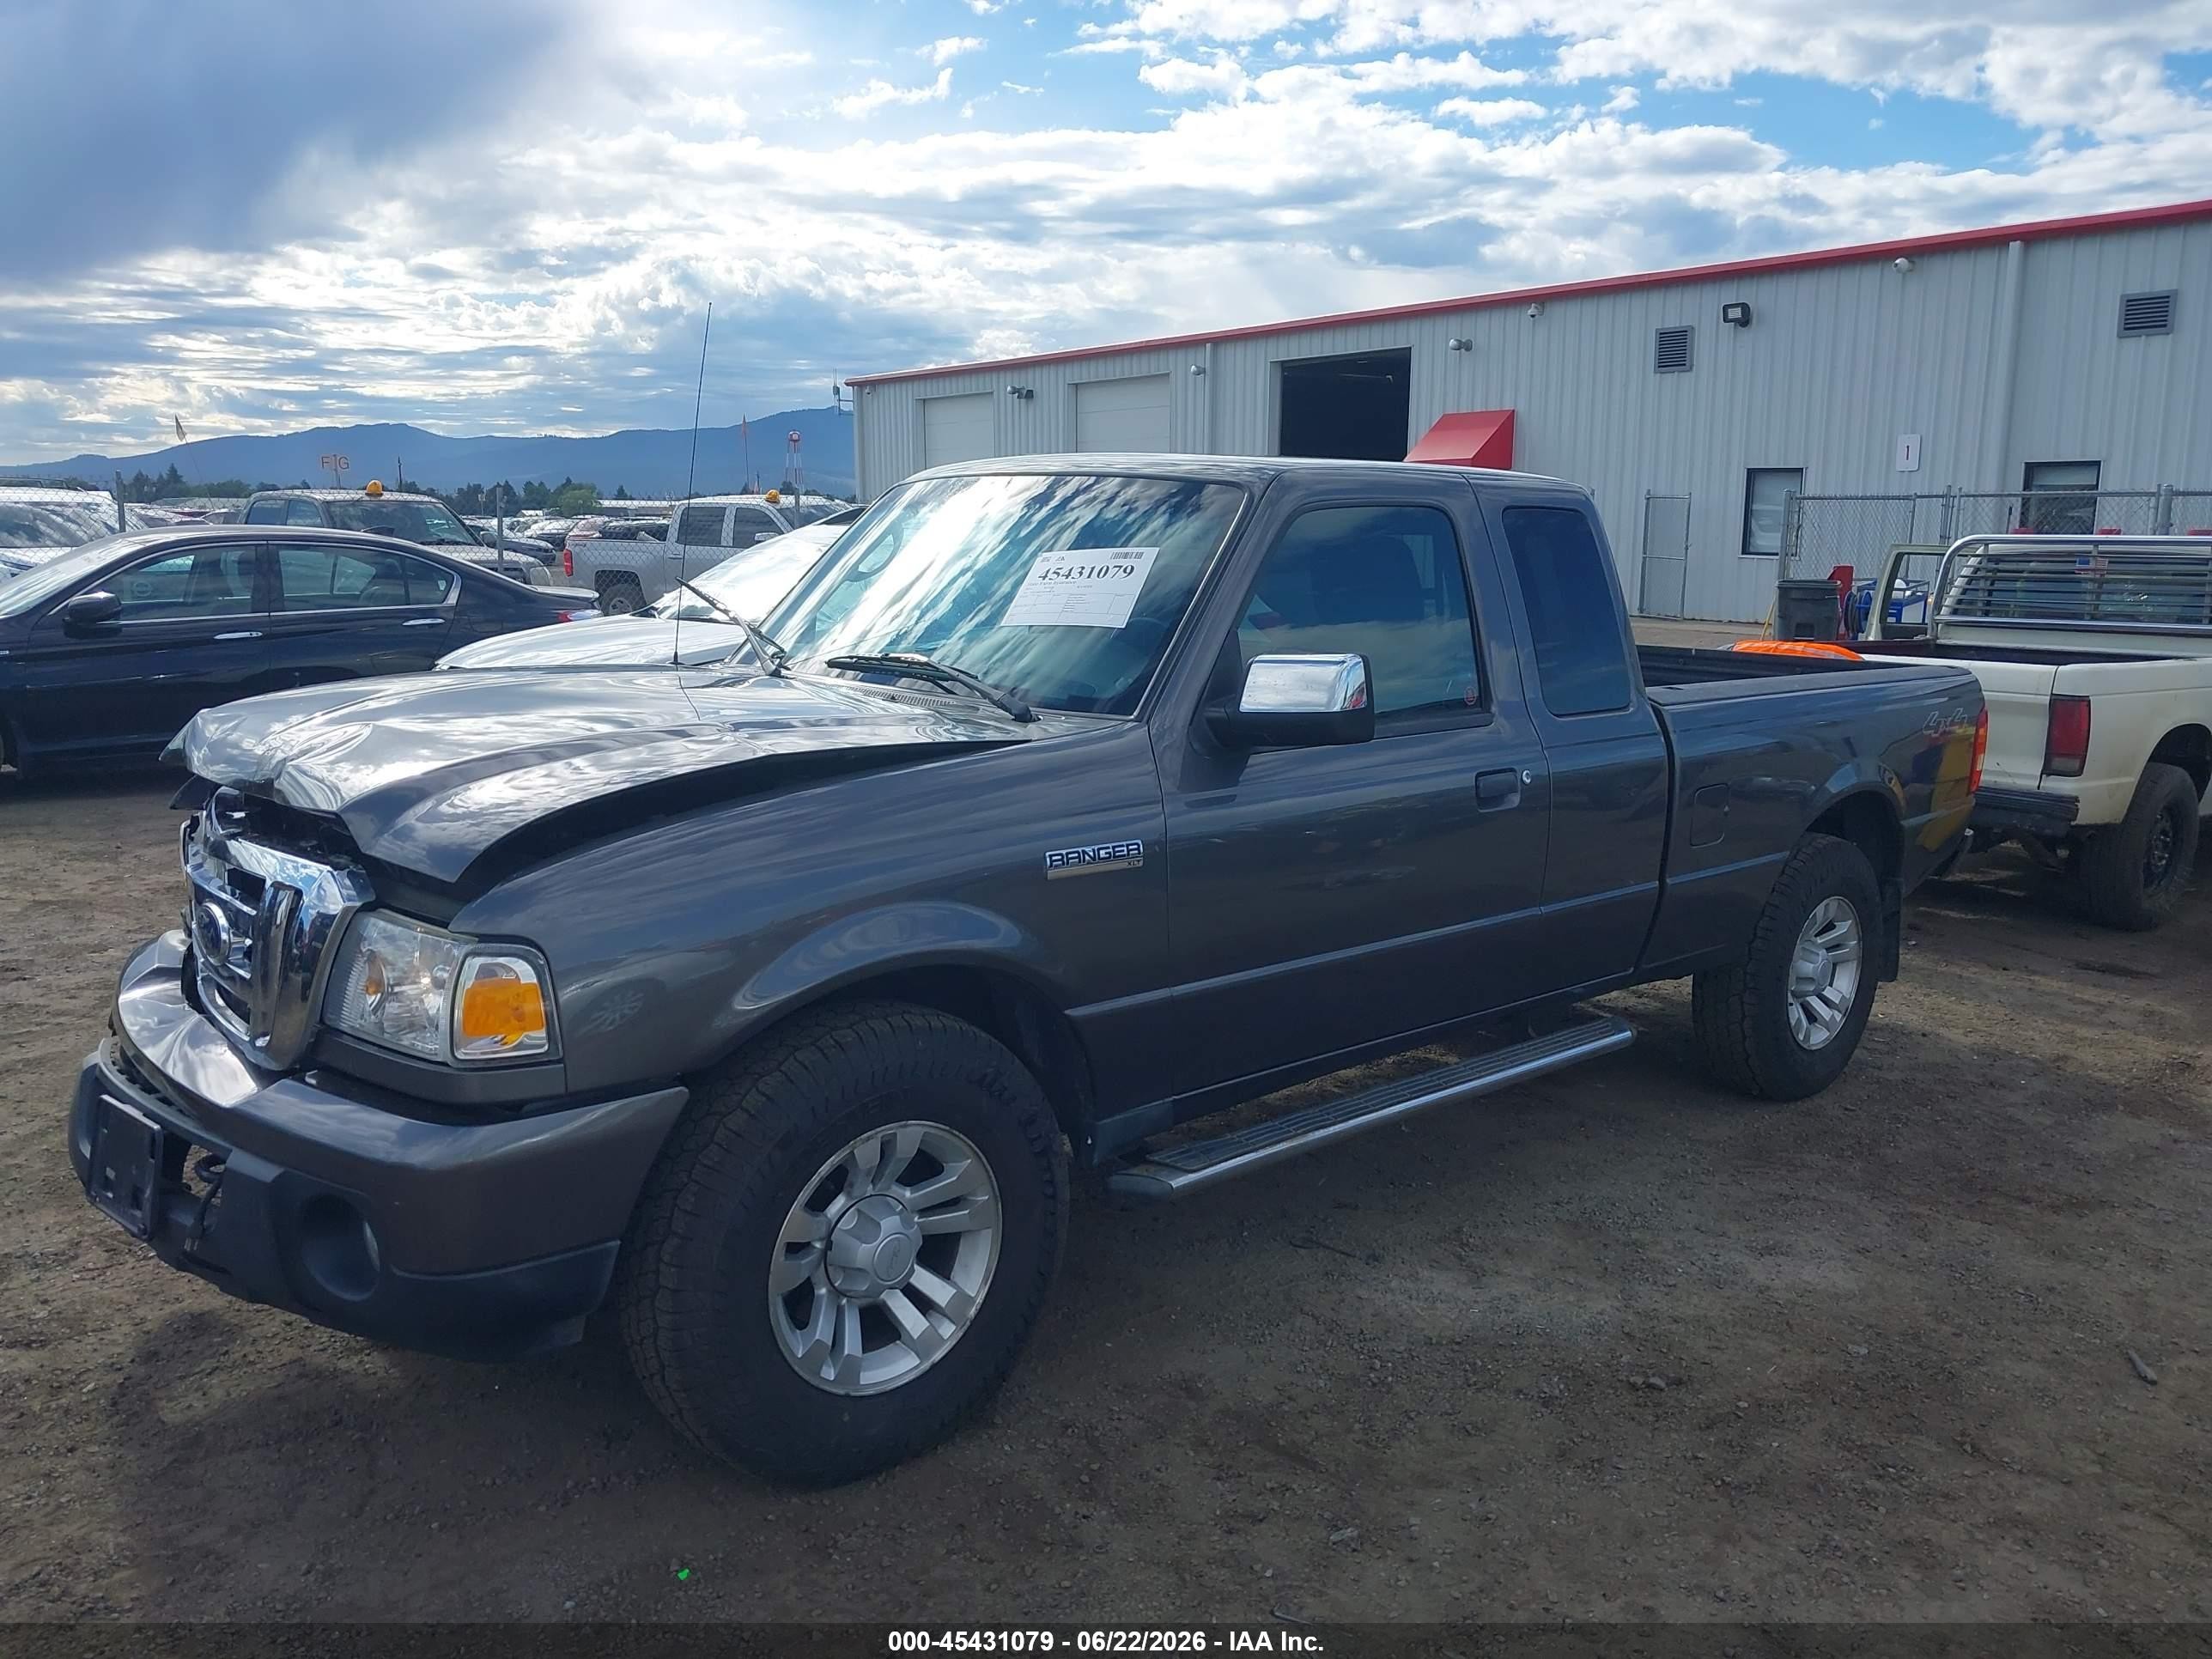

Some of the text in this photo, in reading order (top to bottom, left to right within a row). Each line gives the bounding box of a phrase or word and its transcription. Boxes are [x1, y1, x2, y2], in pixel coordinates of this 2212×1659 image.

[1038, 563, 1135, 581] 45431079
[1922, 708, 1968, 738] 4x4
[1047, 841, 1142, 868] RANGER
[1127, 859, 1142, 867] XLT
